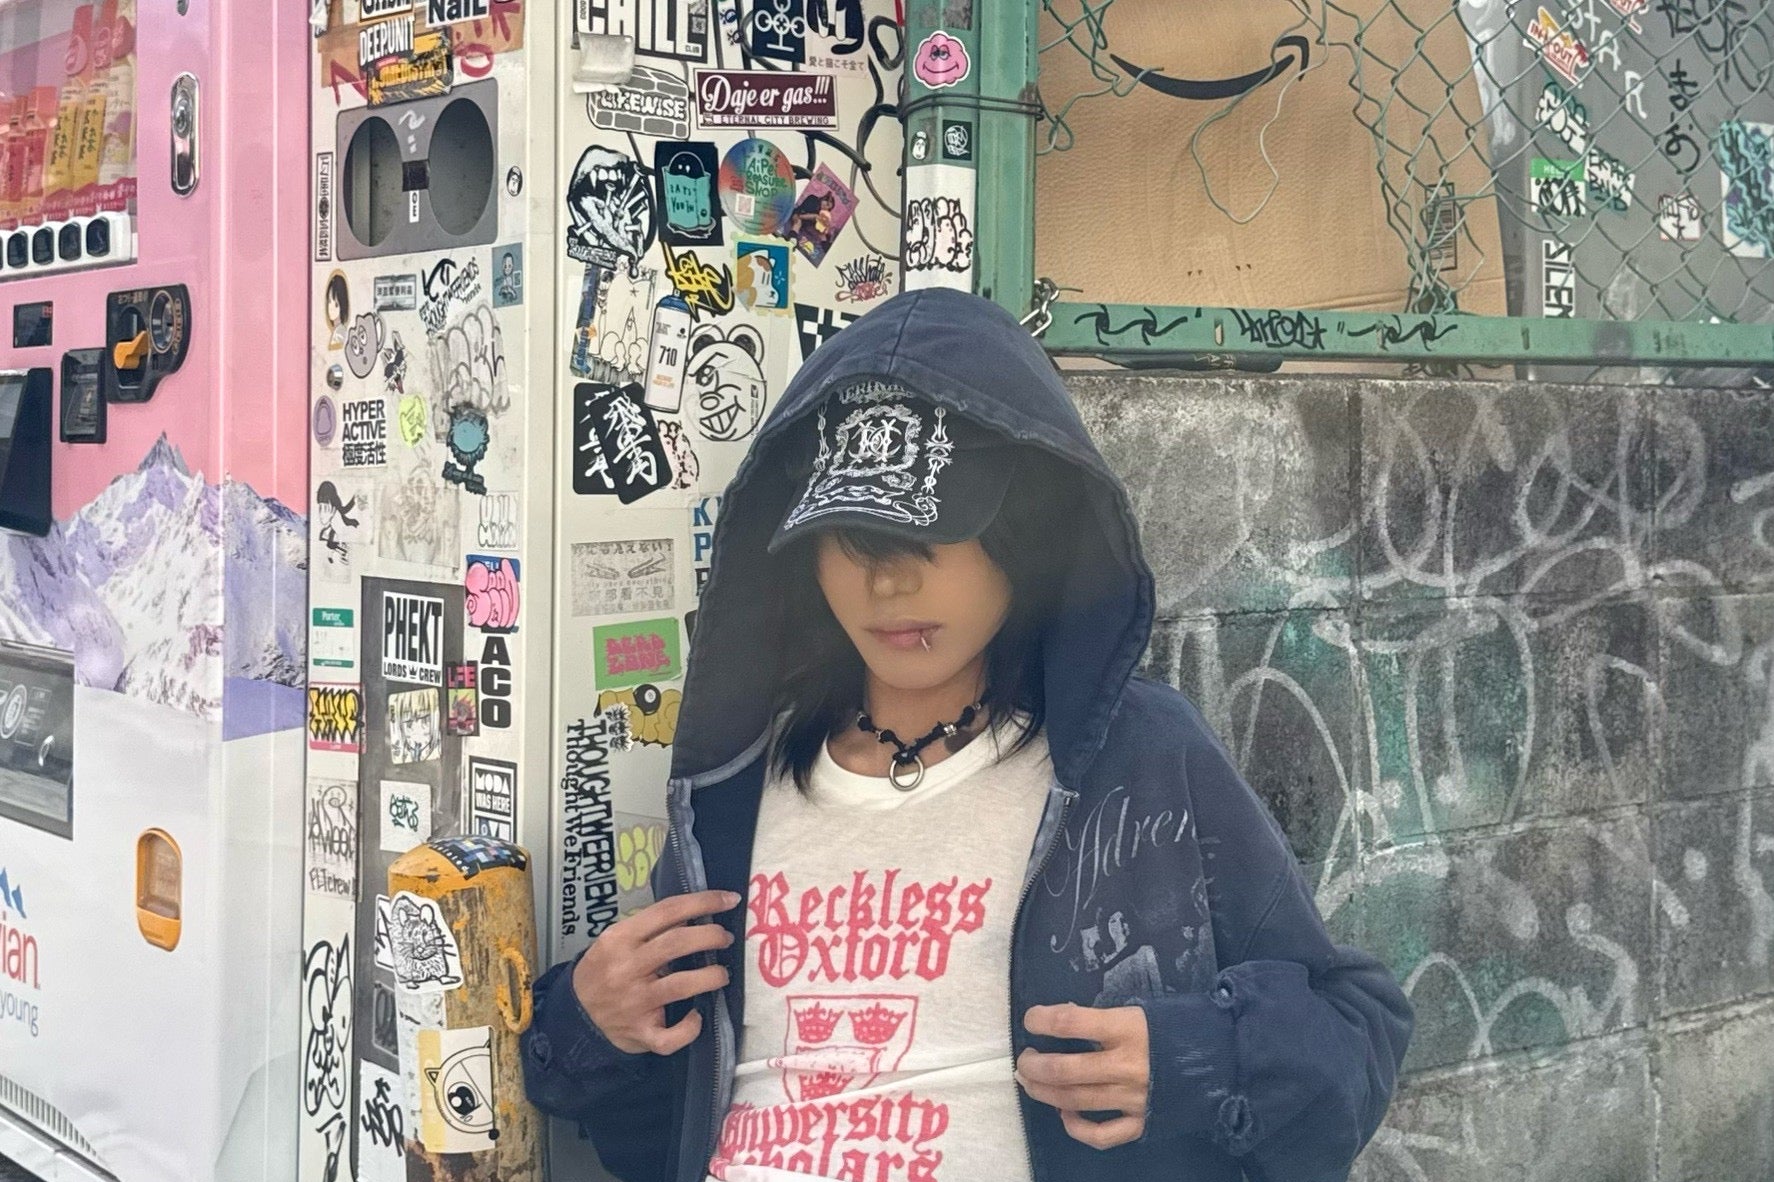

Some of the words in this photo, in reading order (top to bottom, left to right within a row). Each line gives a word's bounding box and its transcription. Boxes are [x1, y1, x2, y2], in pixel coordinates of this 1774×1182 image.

[702, 75, 758, 114] Daje
[759, 87, 781, 100] er
[782, 76, 831, 113] gas!!!
[720, 114, 762, 125] ETERNAL
[764, 115, 787, 126] CITY
[788, 115, 830, 126] BREWING
[658, 345, 678, 367] 710
[342, 399, 385, 421] HYPER
[342, 419, 386, 442] ACTIVE
[384, 595, 442, 665] PHEKT
[383, 661, 408, 679] LORDS
[418, 667, 441, 683] CREW
[480, 626, 512, 729] ACO
[476, 772, 510, 795] MODA
[475, 792, 492, 809] WAS
[492, 795, 511, 814] HERE
[746, 868, 992, 941] Reckless
[757, 925, 953, 988] Oxford
